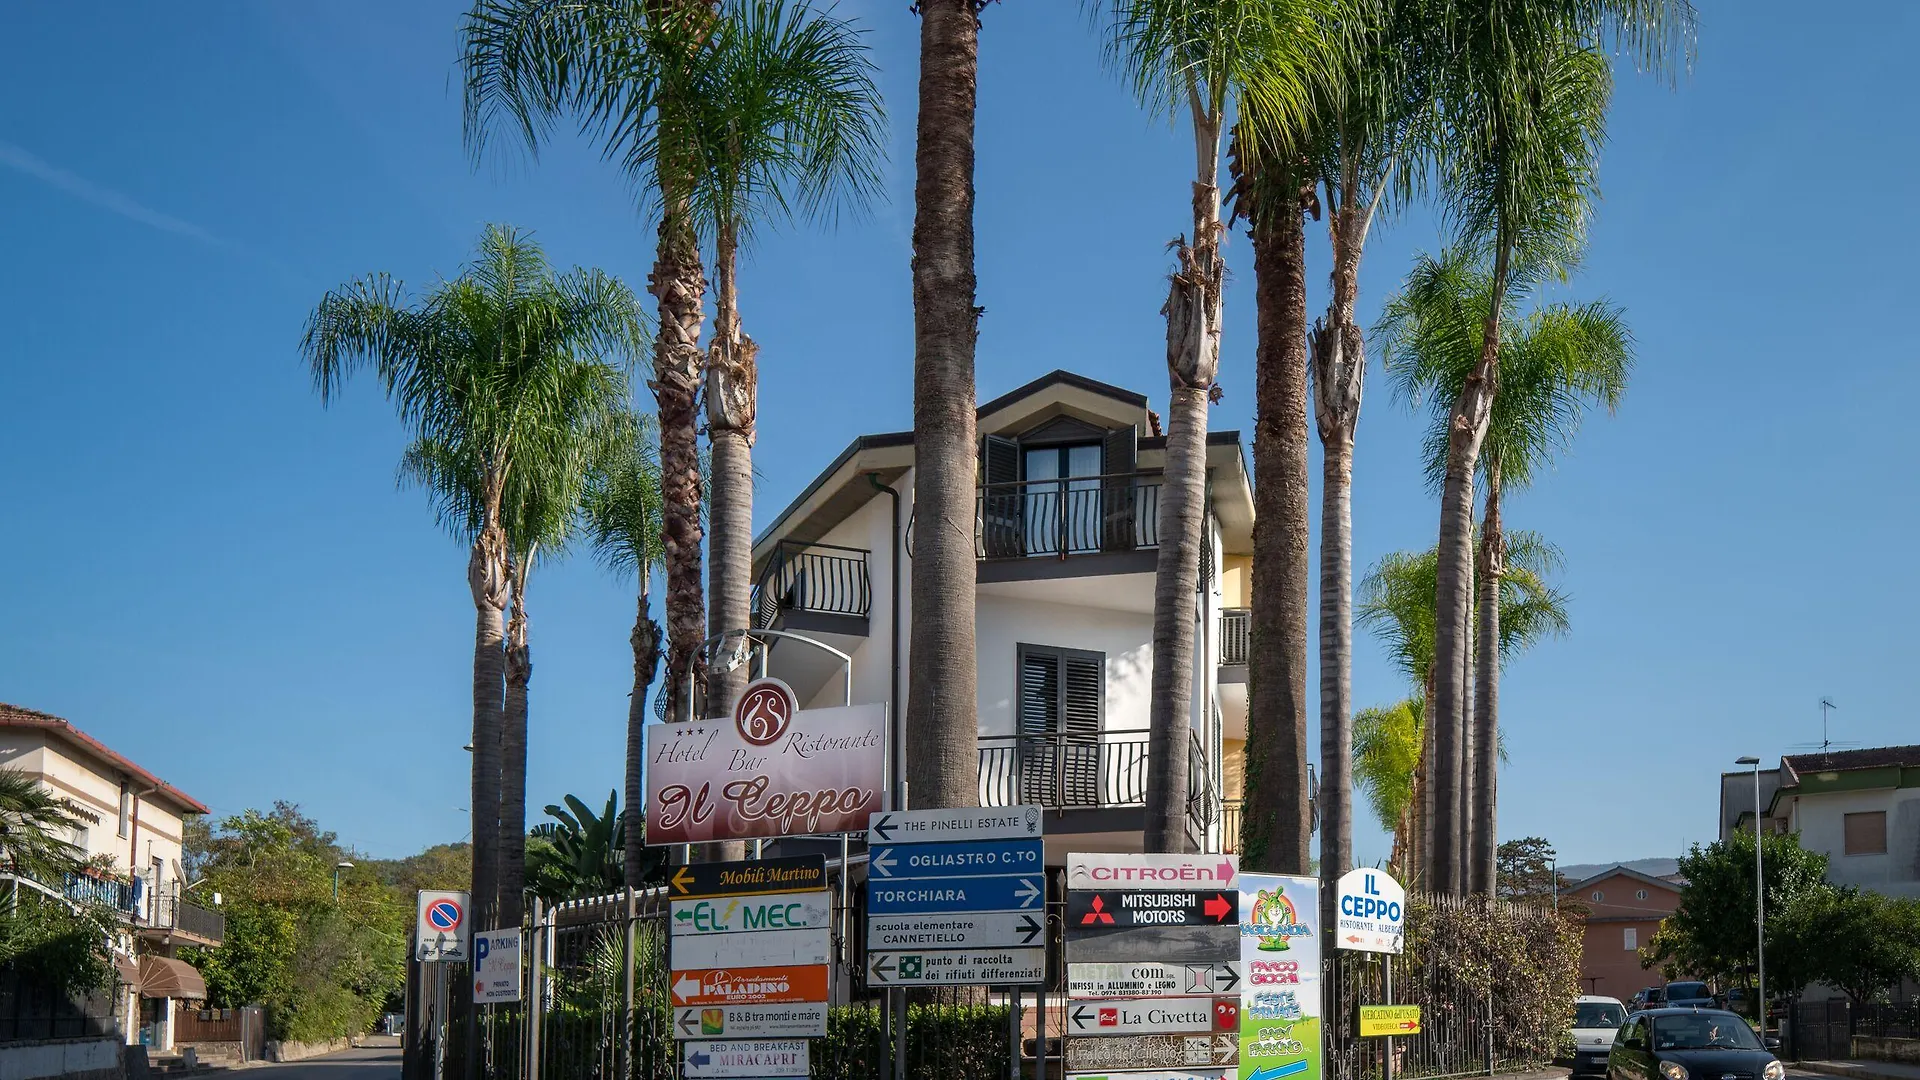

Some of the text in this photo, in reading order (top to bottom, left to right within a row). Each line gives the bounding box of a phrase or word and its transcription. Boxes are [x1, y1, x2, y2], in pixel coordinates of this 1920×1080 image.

[655, 729, 719, 764] Hotel
[782, 730, 879, 758] Ristorante
[727, 749, 767, 772] Bar
[658, 775, 873, 834] Il Ceppo
[905, 817, 1019, 831] THE PINELLI ESTATE
[910, 852, 995, 866] OGLIASTRO
[720, 866, 819, 886] Mobili Martino
[1365, 874, 1379, 895] IL
[875, 890, 966, 902] TORCHIARA
[1122, 894, 1196, 908] MITSUBISHI
[1341, 895, 1400, 921] CEPPO
[1133, 910, 1185, 924] MOTORS
[876, 921, 973, 931] scuola elementare
[1340, 920, 1373, 931] RISTORANTE
[884, 934, 965, 943] CANNETIELLO
[476, 937, 518, 971] PARKING
[926, 955, 1012, 967] punto di raccolta
[925, 968, 1042, 980] dei rifiuti differenziati
[1132, 966, 1164, 979] com
[1249, 960, 1300, 974] PARCO
[1070, 982, 1095, 990] INFISSI
[1097, 982, 1104, 990] in
[1108, 982, 1144, 990] ALLUMINIO
[1155, 981, 1176, 989] LEGNO
[1249, 973, 1300, 986] GIOCHI
[704, 983, 789, 995] PALADINO
[730, 1011, 820, 1022] B & B tra monti e mare
[1122, 1010, 1207, 1025] La Civetta
[1362, 1010, 1393, 1020] MERCATINO
[1258, 1025, 1293, 1042] BABY
[710, 1042, 804, 1052] BED AND BREAKFAST
[1248, 1040, 1302, 1055] PARKING
[720, 1053, 796, 1066] MIRACAPRI
